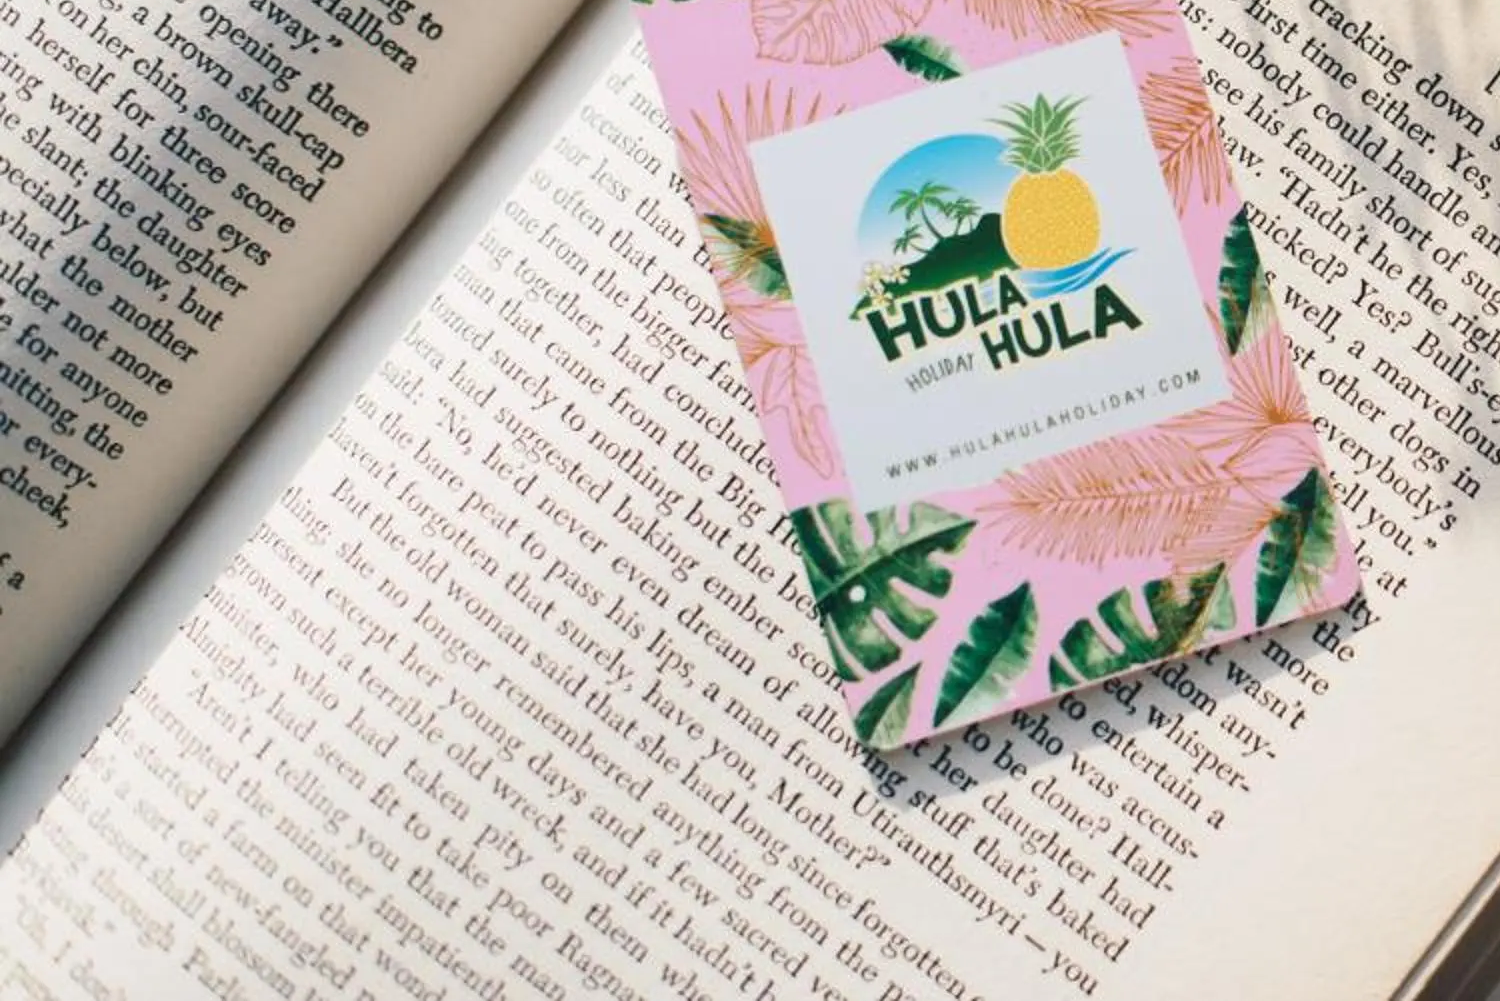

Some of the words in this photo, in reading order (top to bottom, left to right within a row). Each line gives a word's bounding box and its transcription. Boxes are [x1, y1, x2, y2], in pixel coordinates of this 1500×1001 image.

[25, 17, 116, 95] herself
[159, 125, 227, 184] three
[231, 182, 296, 234] score
[153, 12, 233, 90] brown
[235, 83, 345, 175] skull-cap
[199, 4, 302, 93] opening
[306, 82, 370, 138] there
[1300, 36, 1358, 90] time
[1361, 88, 1436, 154] either.
[1446, 142, 1492, 200] Yes,
[1415, 72, 1485, 138] down
[132, 57, 188, 114] chin,
[193, 104, 326, 203] sour-faced
[1203, 68, 1244, 106] see
[1244, 92, 1285, 136] his
[1283, 127, 1367, 202] family
[1365, 194, 1433, 252] short
[1216, 27, 1312, 108] nobody
[1313, 103, 1388, 164] could
[1382, 148, 1470, 227] handle
[21, 125, 89, 188] slant;
[136, 210, 248, 297] daughter
[108, 132, 215, 232] blinking
[217, 223, 272, 267] eyes
[635, 197, 685, 248] than
[91, 222, 171, 302] below,
[177, 284, 224, 332] but
[108, 294, 199, 363] mother
[866, 273, 1028, 361] HULA
[980, 283, 1142, 370] HULA
[1284, 285, 1342, 343] well,
[1351, 278, 1413, 334] Yes?
[1405, 274, 1448, 316] the
[59, 362, 149, 428] anyone
[107, 345, 173, 395] more
[886, 367, 1203, 479] WWW.HULAHULAHOLIDAY.COM
[905, 351, 976, 393] HOLIDAY
[1318, 368, 1386, 423] other
[1389, 419, 1450, 474] dogs
[0, 465, 70, 529] cheek,
[23, 435, 97, 490] every-
[609, 230, 657, 276] that
[1220, 714, 1276, 759] any-
[630, 296, 709, 367] bigger
[1147, 705, 1249, 792] whisper-
[545, 342, 605, 394] came
[717, 472, 766, 528] Big
[1071, 753, 1119, 799] was
[1121, 797, 1199, 859] accus-
[1311, 619, 1355, 662] the
[494, 407, 614, 504] suggested
[612, 495, 700, 583] baking
[703, 576, 784, 640] ember
[929, 744, 979, 792] her
[982, 792, 1096, 884] daughter
[1099, 876, 1156, 930] had
[588, 430, 684, 516] nothing
[684, 497, 731, 549] but
[1030, 776, 1111, 840] done?
[1108, 834, 1173, 892] Hall-
[1261, 638, 1329, 695] more
[493, 675, 654, 802] remembered
[652, 802, 765, 900] anything
[611, 556, 670, 608] even
[677, 604, 756, 676] dream
[796, 703, 908, 799] allowing
[908, 790, 975, 839] stuff
[1045, 886, 1131, 963] baked
[641, 678, 704, 740] have
[708, 737, 756, 790] you,
[1091, 719, 1202, 812] entertain
[275, 759, 350, 835] telling
[492, 777, 565, 852] wreck,
[530, 652, 589, 698] said
[680, 762, 736, 815] had
[731, 801, 789, 866] long
[850, 898, 966, 999] forgotten
[646, 628, 695, 688] lips,
[783, 739, 844, 799] from
[1041, 950, 1098, 996] you
[584, 904, 648, 955] them
